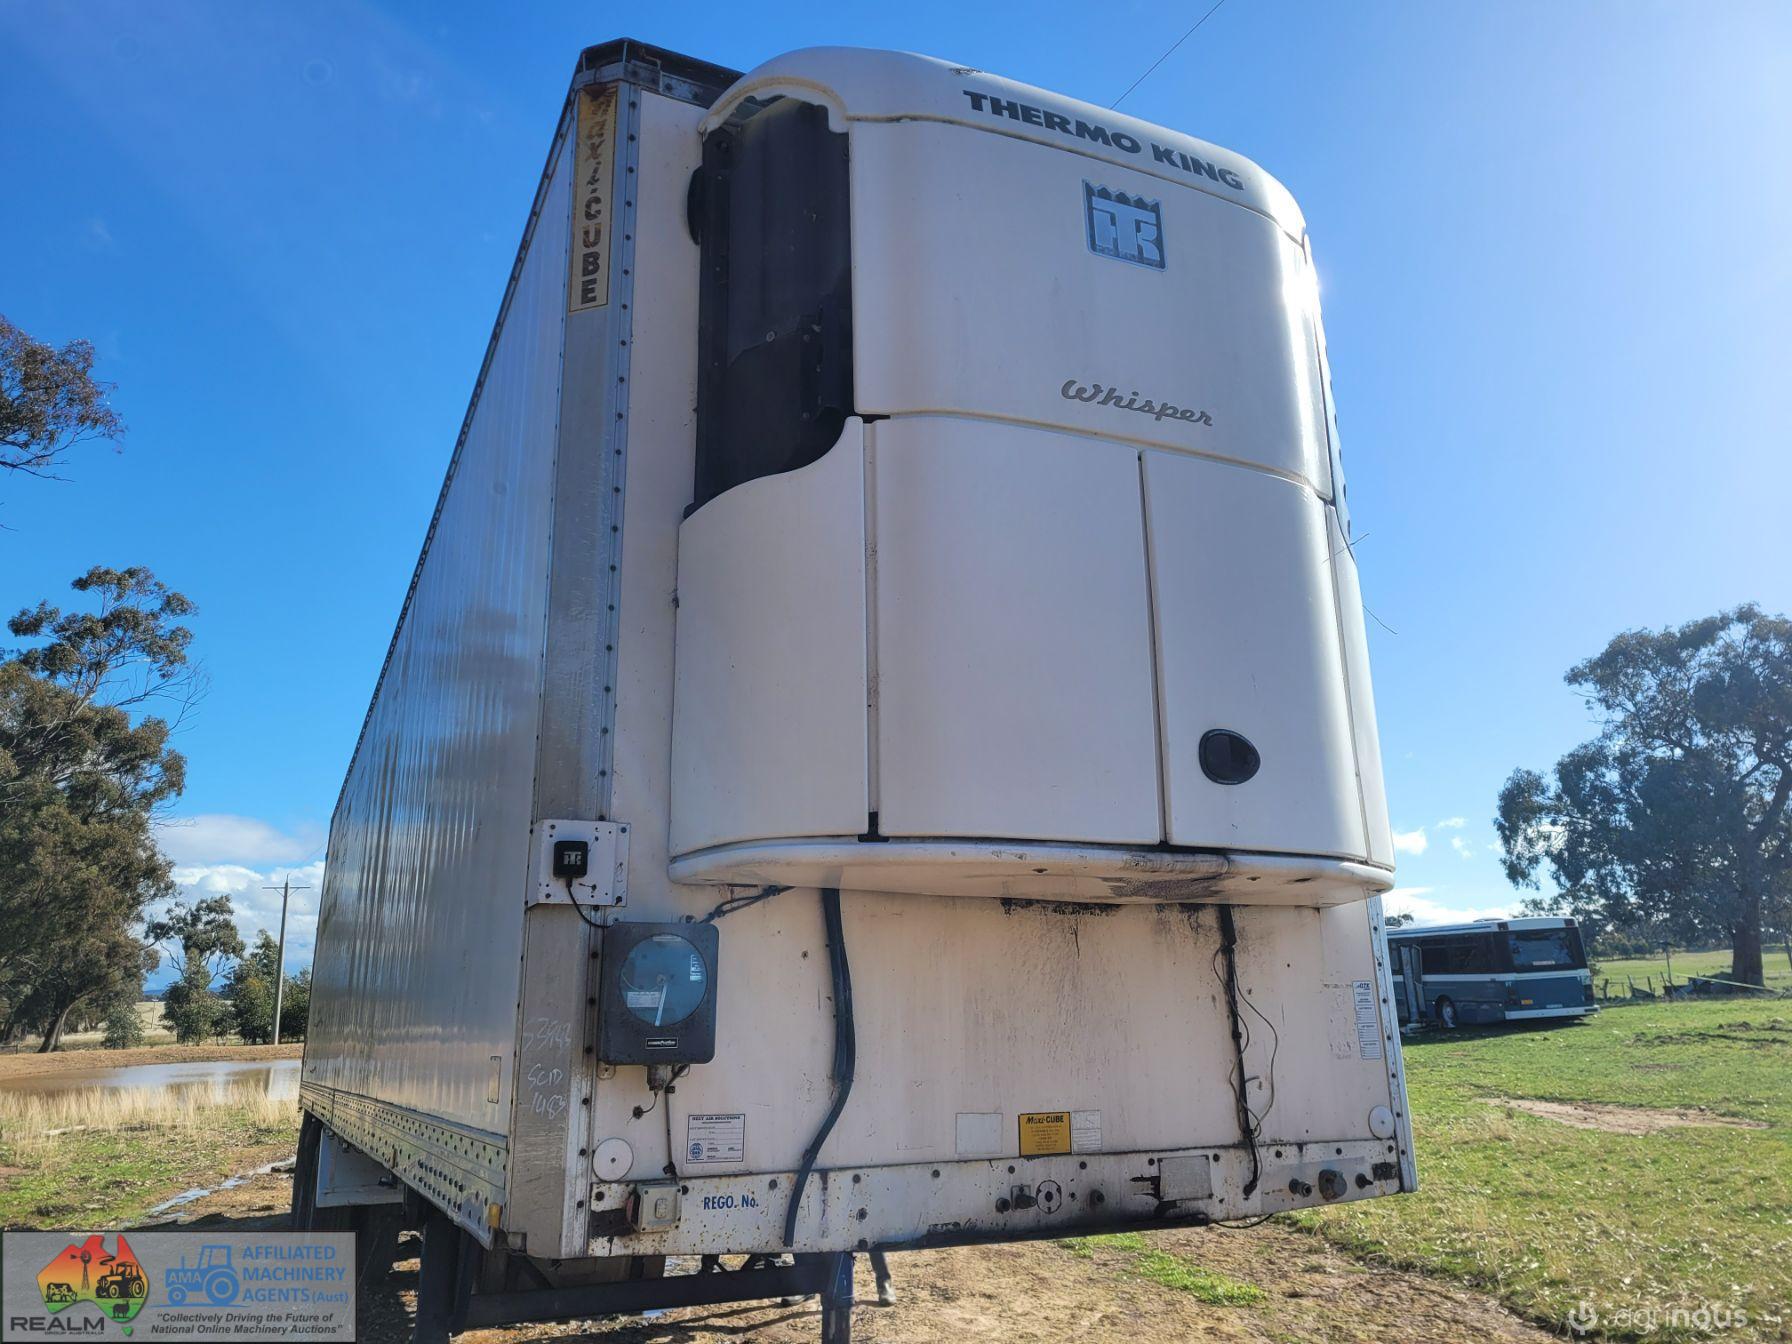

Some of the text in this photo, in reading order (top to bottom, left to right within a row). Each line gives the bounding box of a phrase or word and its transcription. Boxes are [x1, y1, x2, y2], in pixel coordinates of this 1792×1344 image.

[962, 90, 1245, 191] THERMO KING
[1061, 379, 1213, 427] Whisper
